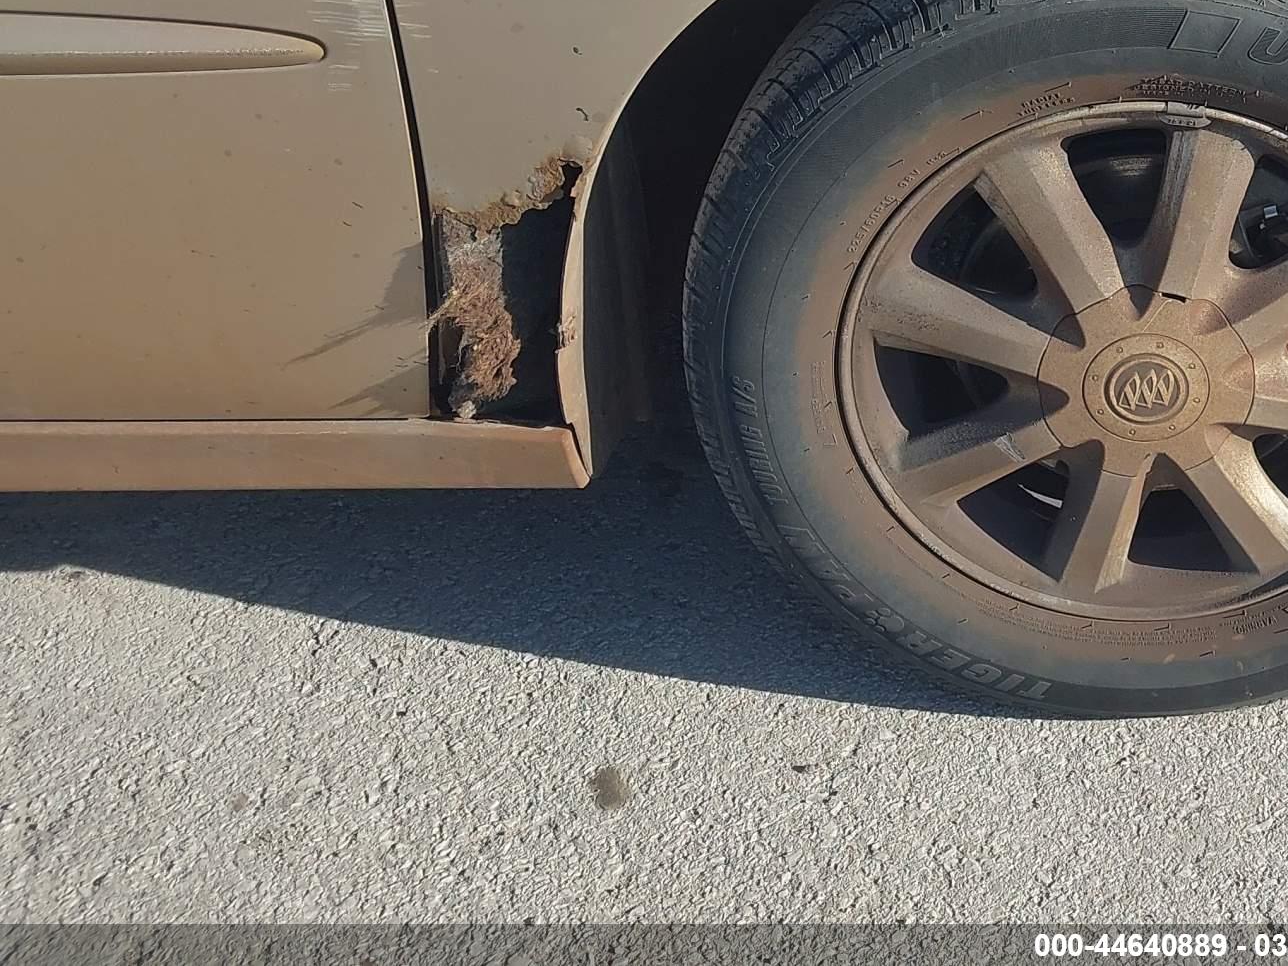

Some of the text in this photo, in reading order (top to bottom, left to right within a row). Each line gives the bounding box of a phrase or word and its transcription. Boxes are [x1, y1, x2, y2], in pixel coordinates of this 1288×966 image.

[731, 375, 790, 506] TOURING A/S
[776, 524, 875, 608] PAW
[896, 631, 1053, 700] TIGER
